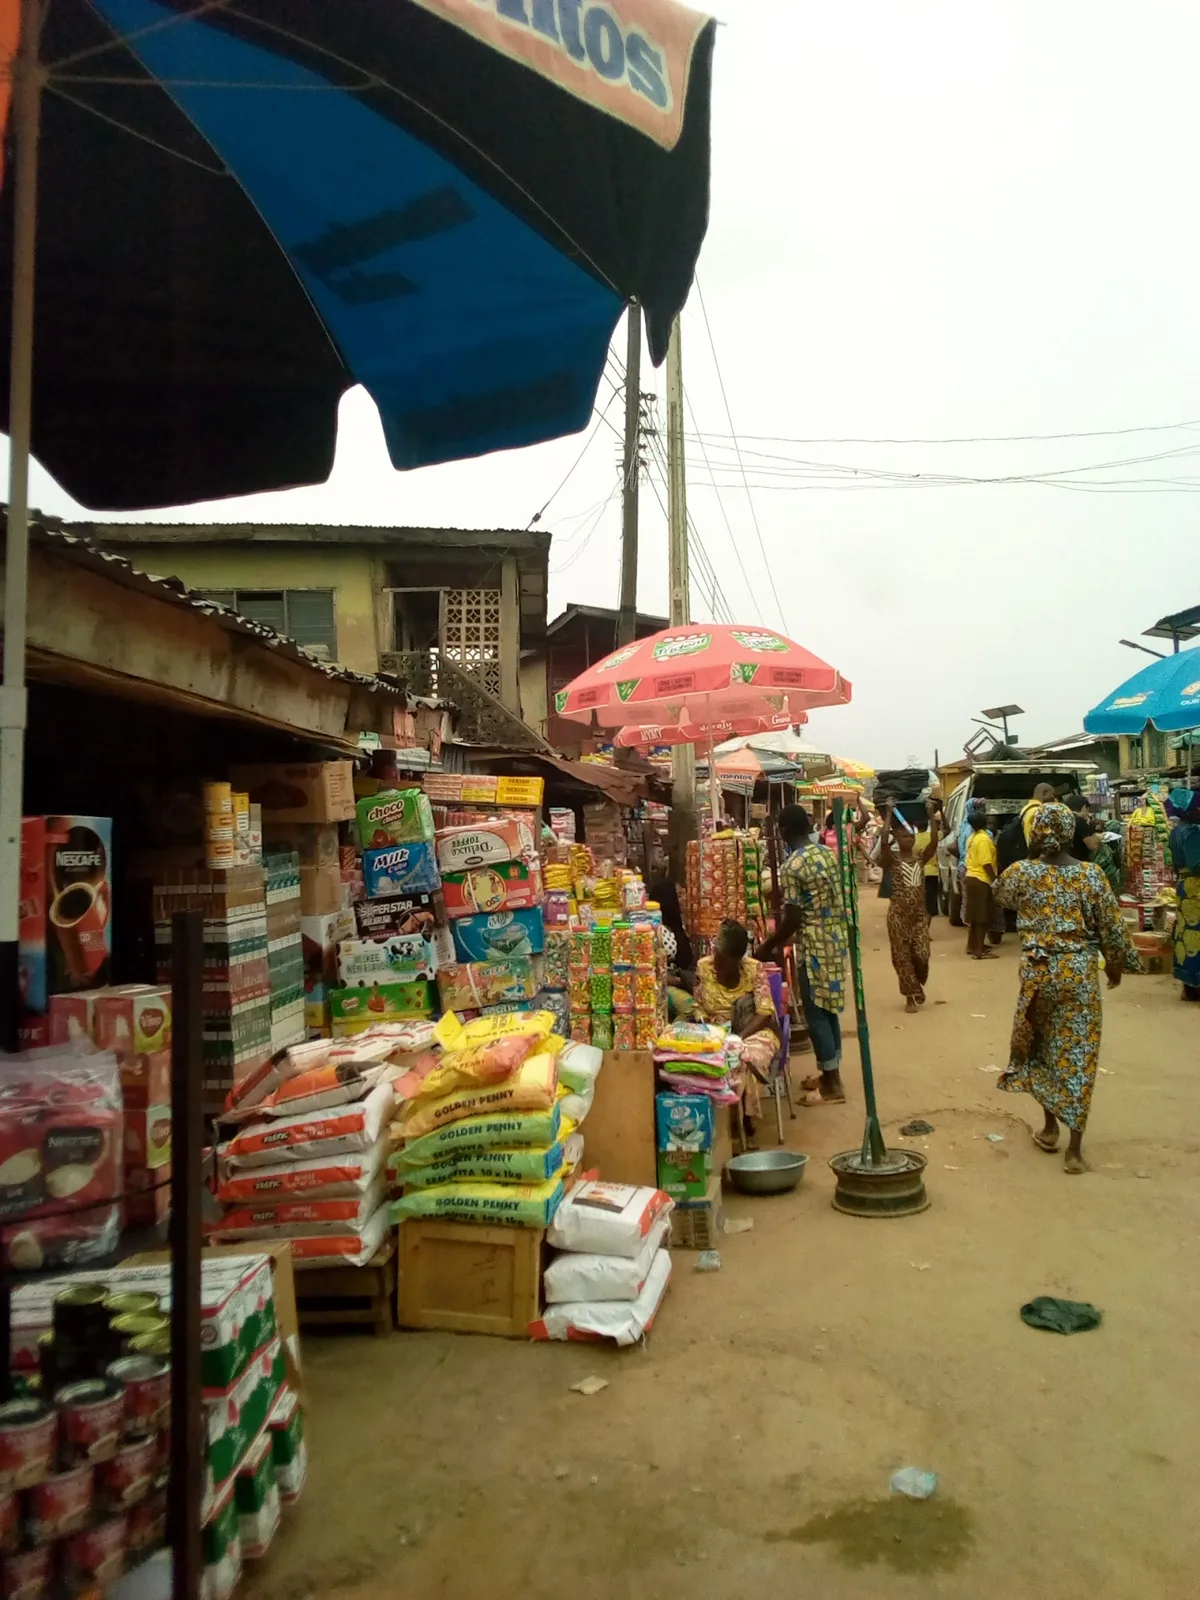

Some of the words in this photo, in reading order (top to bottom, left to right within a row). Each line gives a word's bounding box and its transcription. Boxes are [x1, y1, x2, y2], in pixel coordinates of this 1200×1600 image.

[719, 773, 753, 781] mentos
[368, 800, 404, 821] choco
[451, 836, 480, 848] TOFFEE
[450, 841, 493, 857] Deluxe
[390, 900, 413, 912] STAR
[434, 1095, 476, 1118] GOLDEN
[479, 1089, 515, 1105] PENNY
[439, 1124, 483, 1141] GOLDEN
[486, 1121, 523, 1132] PENNY
[476, 1153, 514, 1163] PENNY
[480, 1168, 492, 1177] 10
[436, 1198, 479, 1207] GOLDEN
[482, 1199, 521, 1211] PENNY
